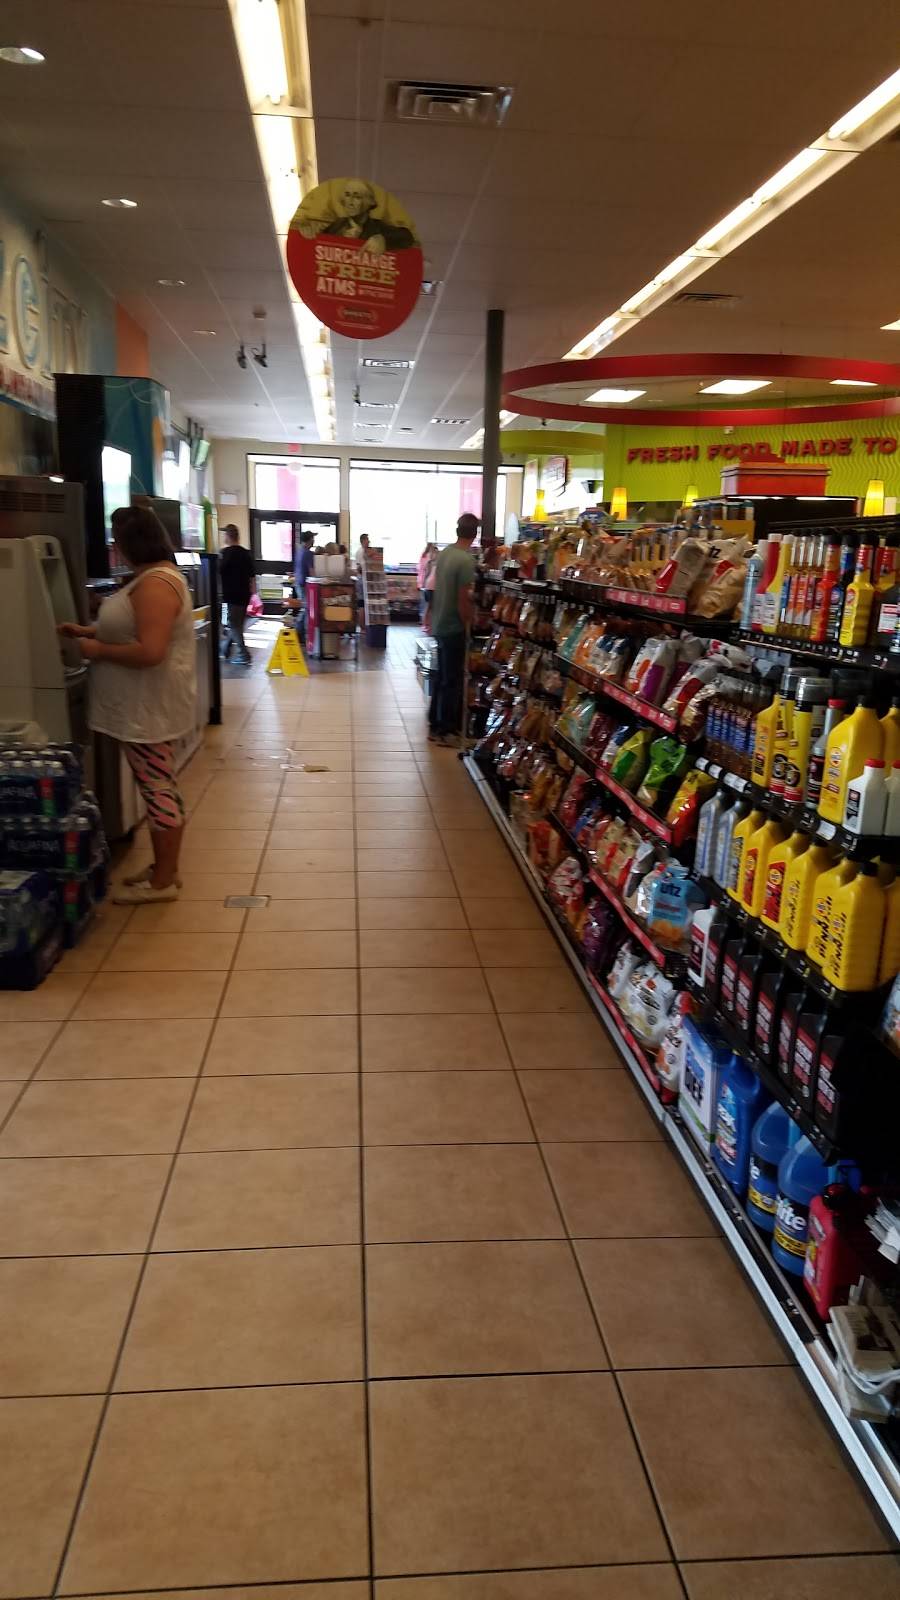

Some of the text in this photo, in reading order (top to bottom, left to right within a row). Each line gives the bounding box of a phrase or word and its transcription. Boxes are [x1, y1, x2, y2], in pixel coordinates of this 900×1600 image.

[315, 261, 399, 285] FREE
[316, 277, 356, 296] ATMS
[626, 436, 897, 464] FRESH FOOD MADE TO
